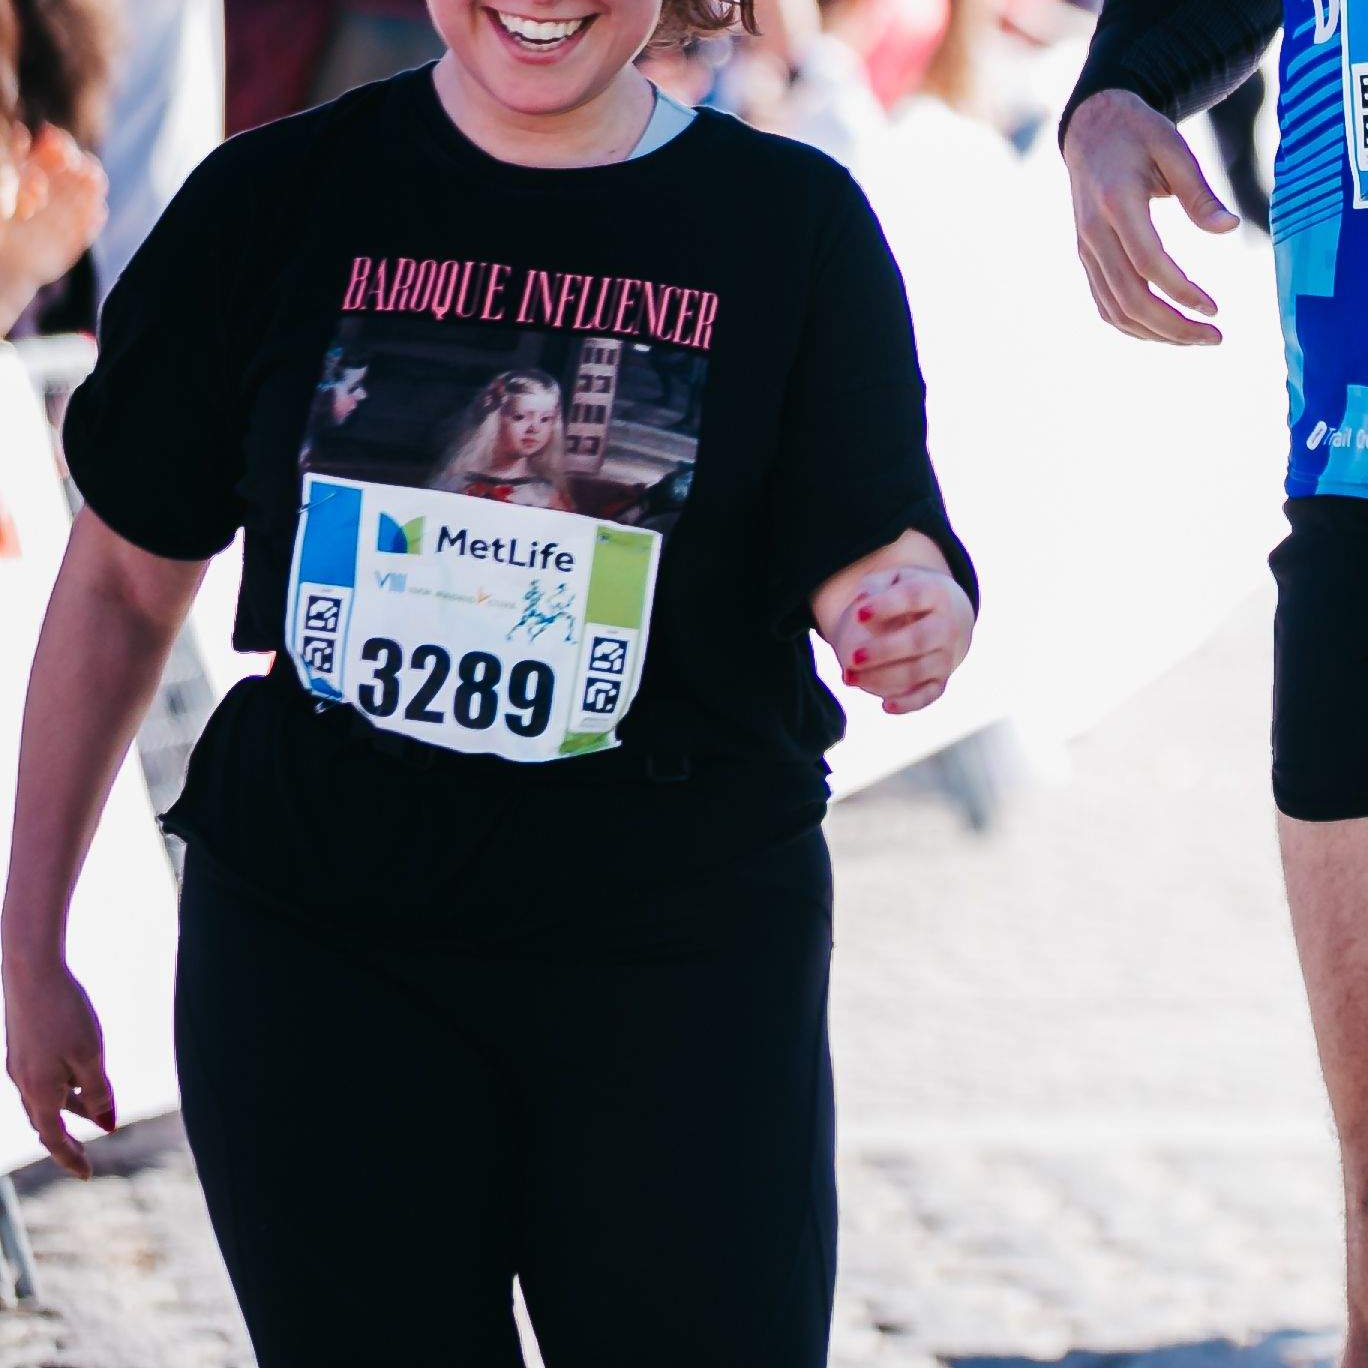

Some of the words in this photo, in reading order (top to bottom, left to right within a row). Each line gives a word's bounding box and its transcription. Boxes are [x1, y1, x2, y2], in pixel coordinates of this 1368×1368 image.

[342, 256, 511, 322] BAROQUE
[518, 268, 721, 351] INFLUENCER
[436, 525, 576, 574] MetLife
[357, 637, 556, 737] 3289
